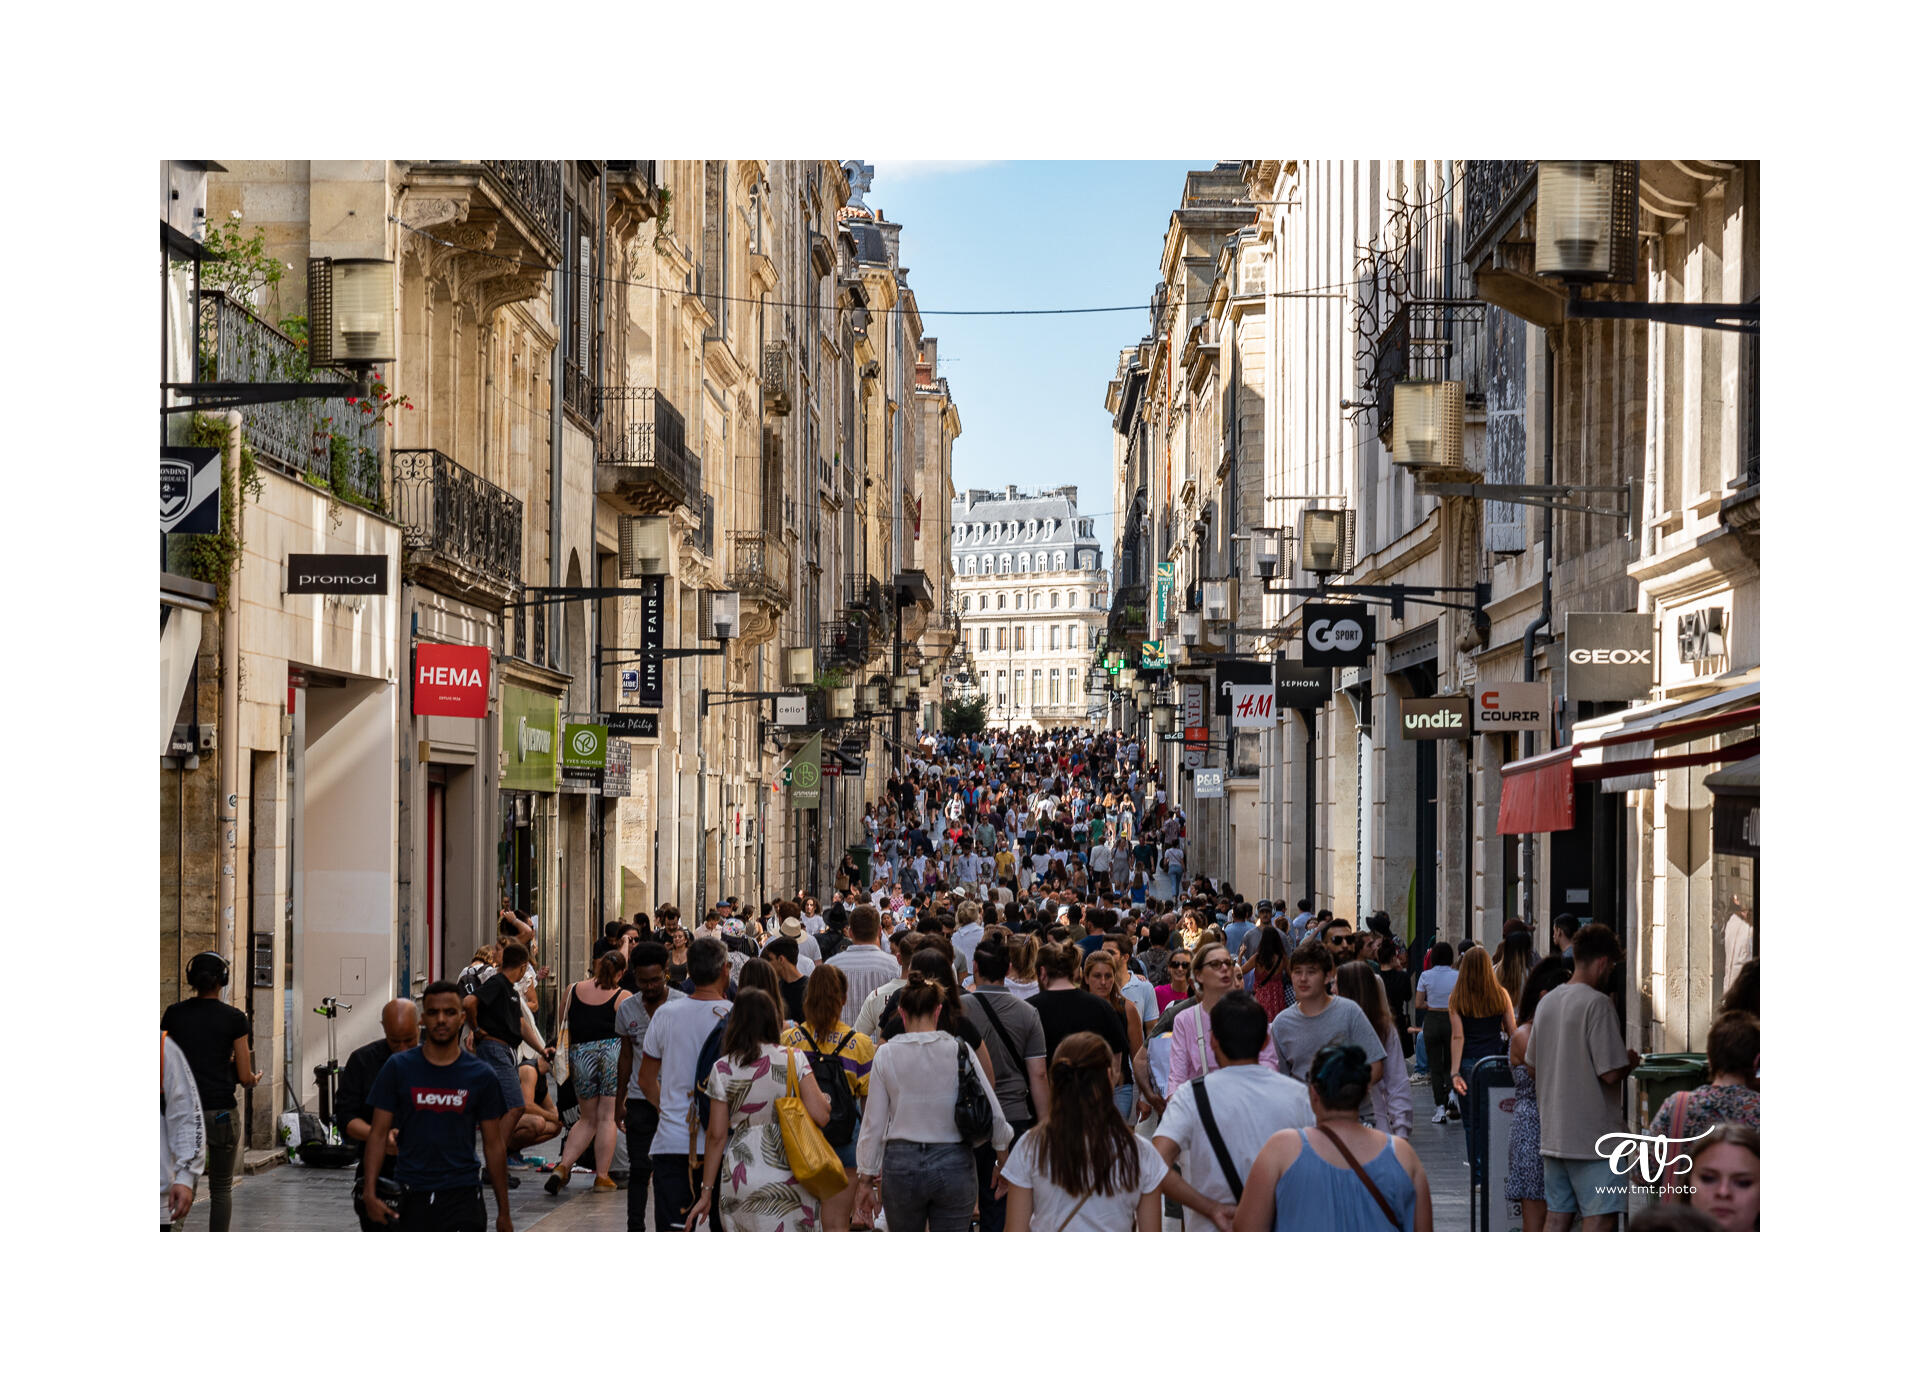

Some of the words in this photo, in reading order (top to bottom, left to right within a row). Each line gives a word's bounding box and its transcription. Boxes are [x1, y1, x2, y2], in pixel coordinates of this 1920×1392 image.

[299, 574, 377, 586] promod
[1307, 619, 1363, 651] GO
[1335, 630, 1359, 641] SPORT
[1569, 649, 1651, 664] GEOX
[647, 641, 656, 690] JIMY
[419, 666, 482, 687] HEMA
[1236, 694, 1273, 718] H&M
[1405, 709, 1463, 729] undiz
[1481, 711, 1539, 721] COURIR
[1196, 774, 1221, 786] P&B
